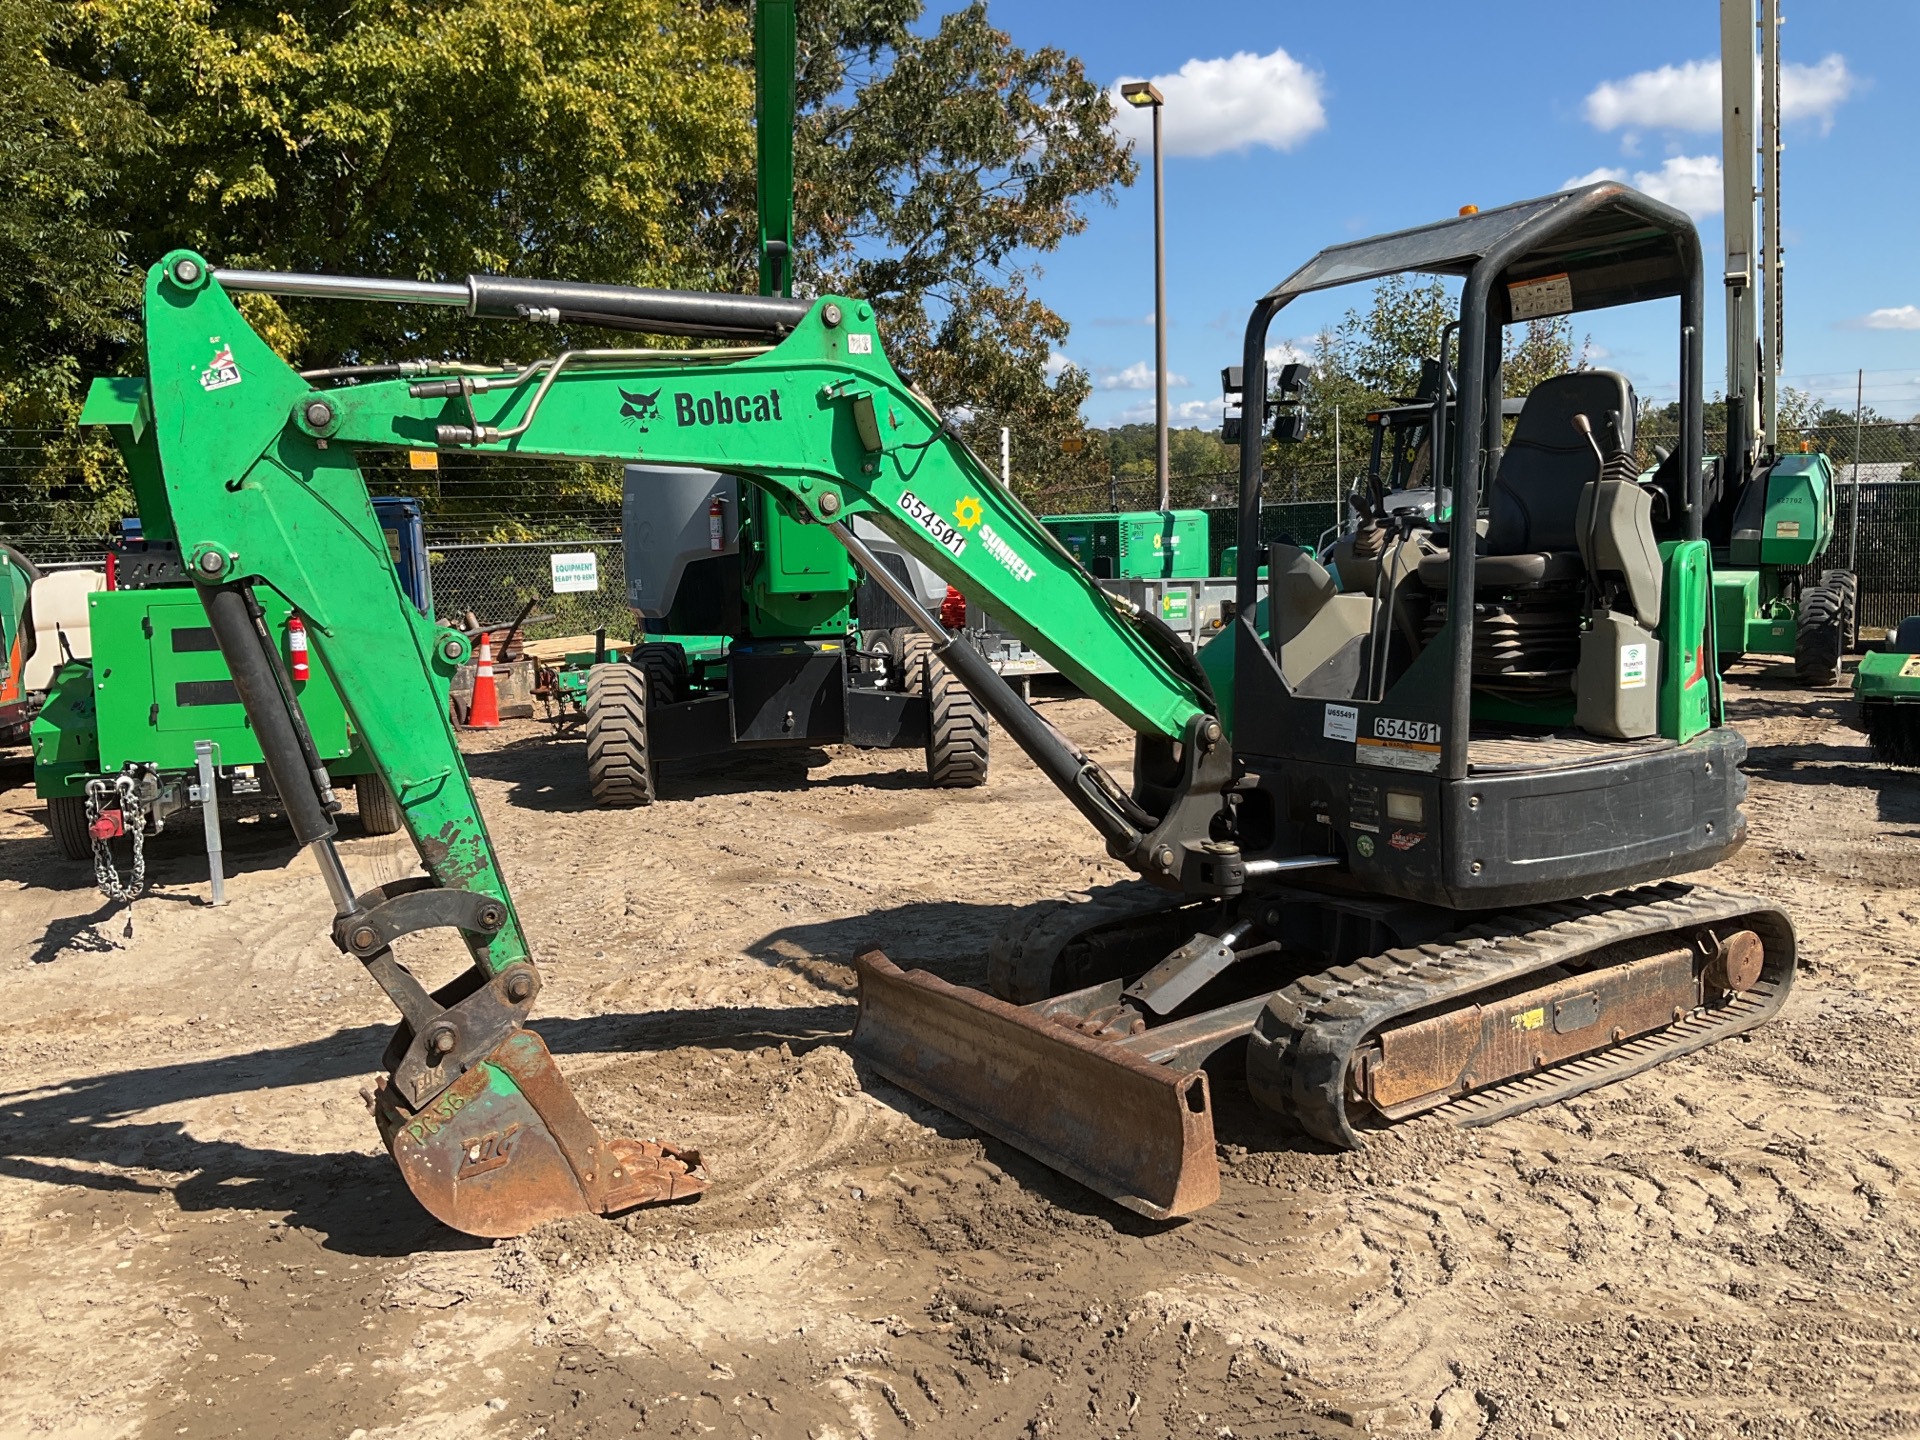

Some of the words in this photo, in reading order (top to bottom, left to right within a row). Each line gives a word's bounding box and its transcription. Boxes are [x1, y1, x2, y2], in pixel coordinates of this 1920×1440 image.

[674, 389, 783, 427] Bobcat
[900, 491, 965, 553] 654501
[555, 563, 593, 573] EQUIPMENT
[978, 524, 1037, 583] SUNBELT
[981, 541, 1022, 582] RENTALS
[554, 574, 572, 582] READY
[582, 573, 595, 581] RENT
[1327, 708, 1356, 720] U655491
[1375, 718, 1438, 742] 654501
